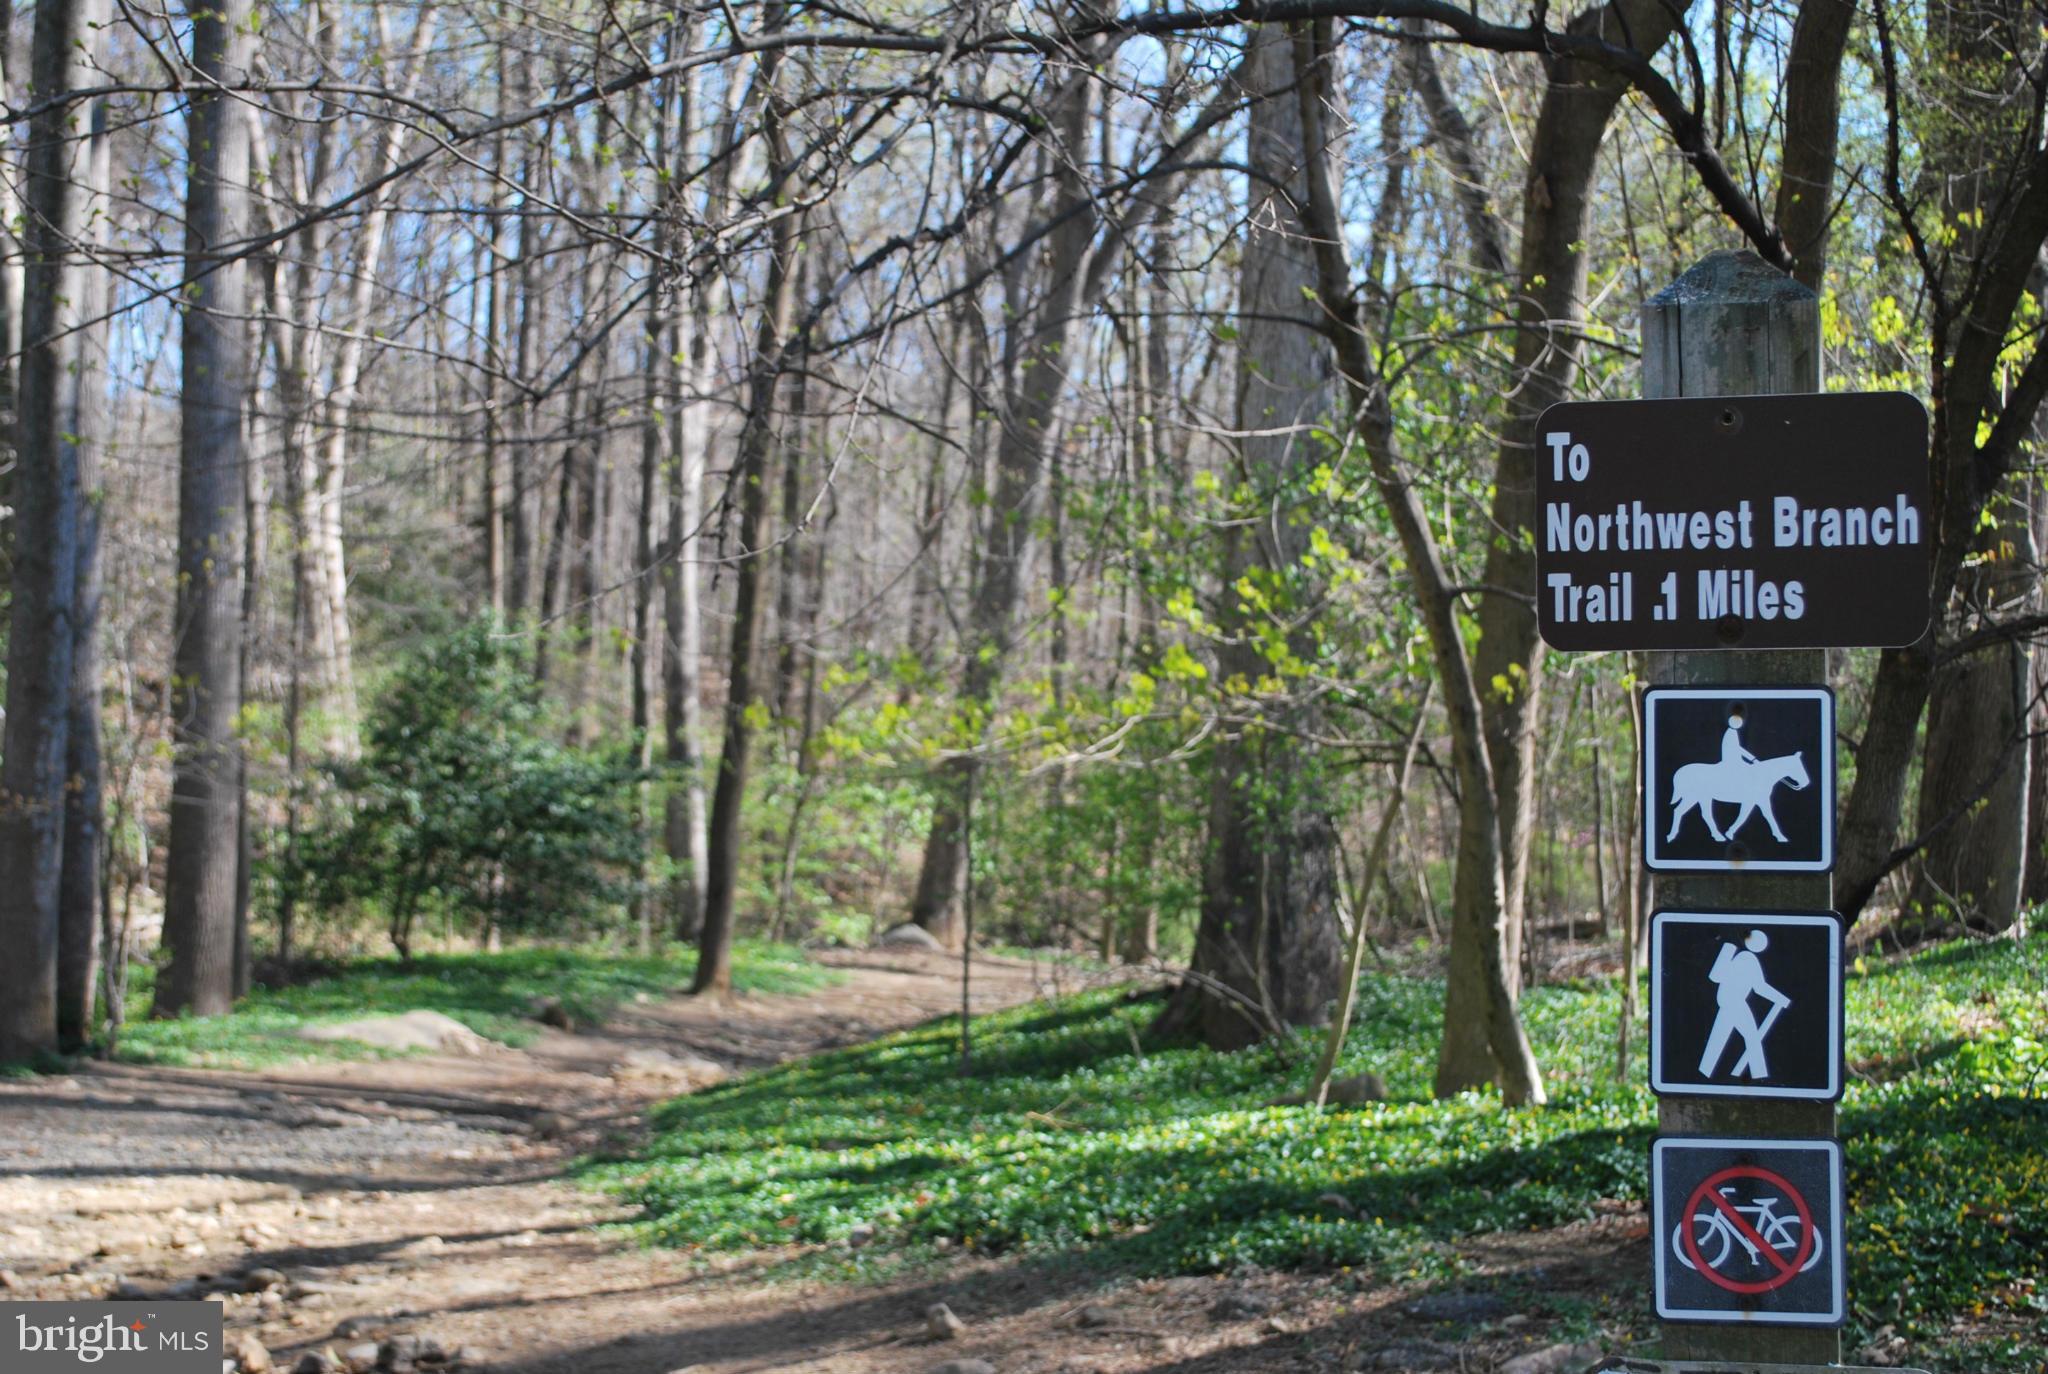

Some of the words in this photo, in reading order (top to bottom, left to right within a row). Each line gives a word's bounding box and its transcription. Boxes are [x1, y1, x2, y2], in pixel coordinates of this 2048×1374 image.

[1546, 431, 1590, 482] To
[1546, 499, 1753, 552] Northwest
[1773, 494, 1919, 548] Branch
[1547, 571, 1633, 623] Trail
[1653, 571, 1678, 621] .1
[1697, 569, 1805, 621] Miles
